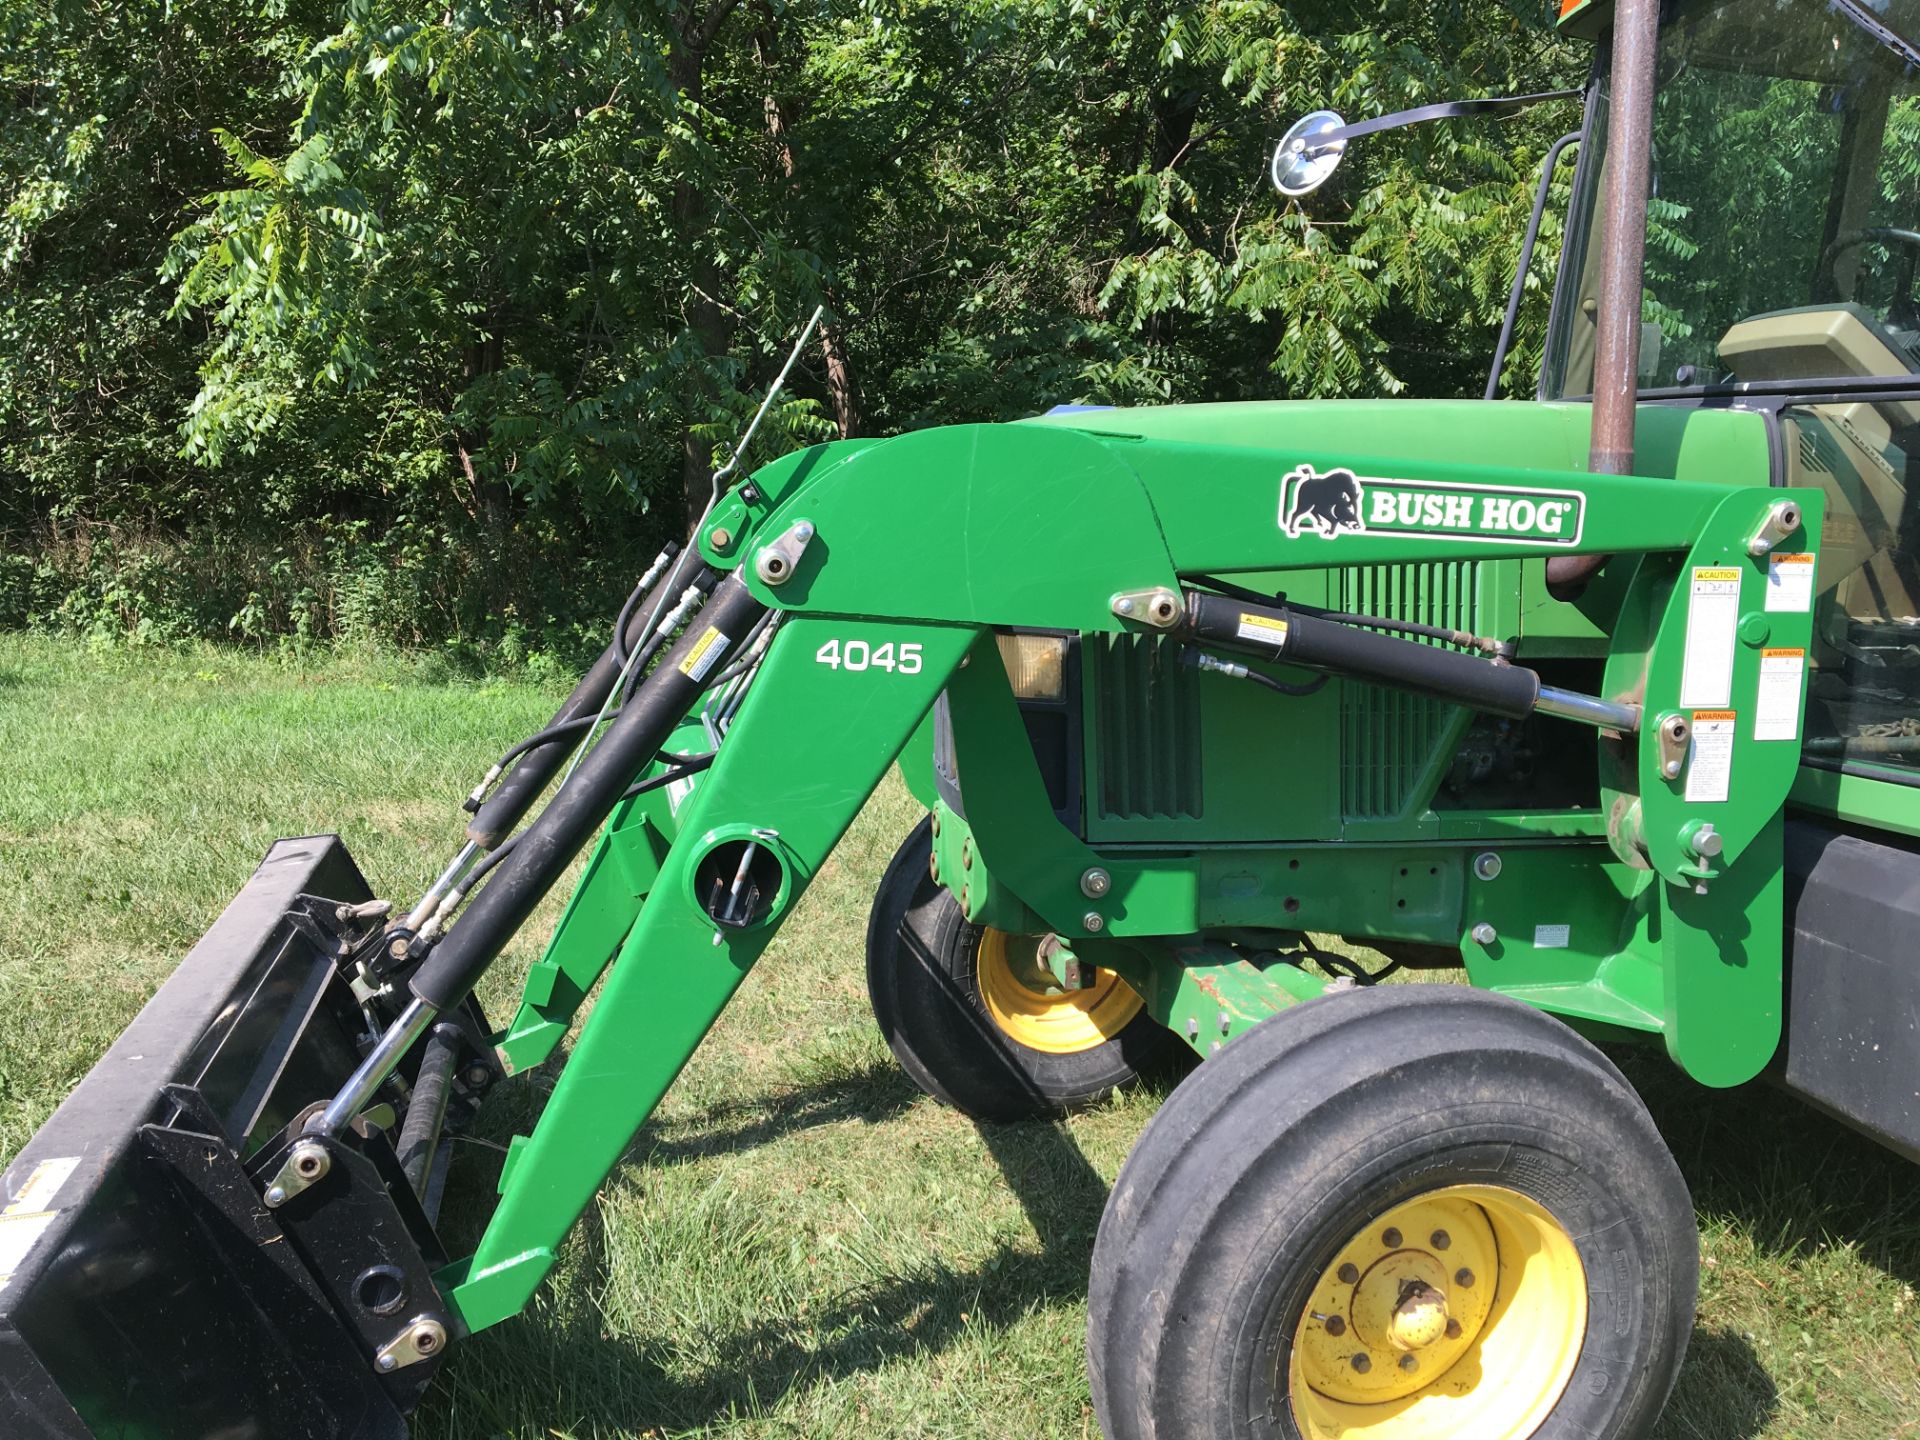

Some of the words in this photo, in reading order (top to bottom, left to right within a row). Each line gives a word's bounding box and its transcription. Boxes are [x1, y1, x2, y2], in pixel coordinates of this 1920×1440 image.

[1370, 491, 1472, 529] BUSH
[1704, 571, 1737, 579] CAUTION
[816, 639, 923, 674] 4045
[1701, 712, 1735, 720] WARNING
